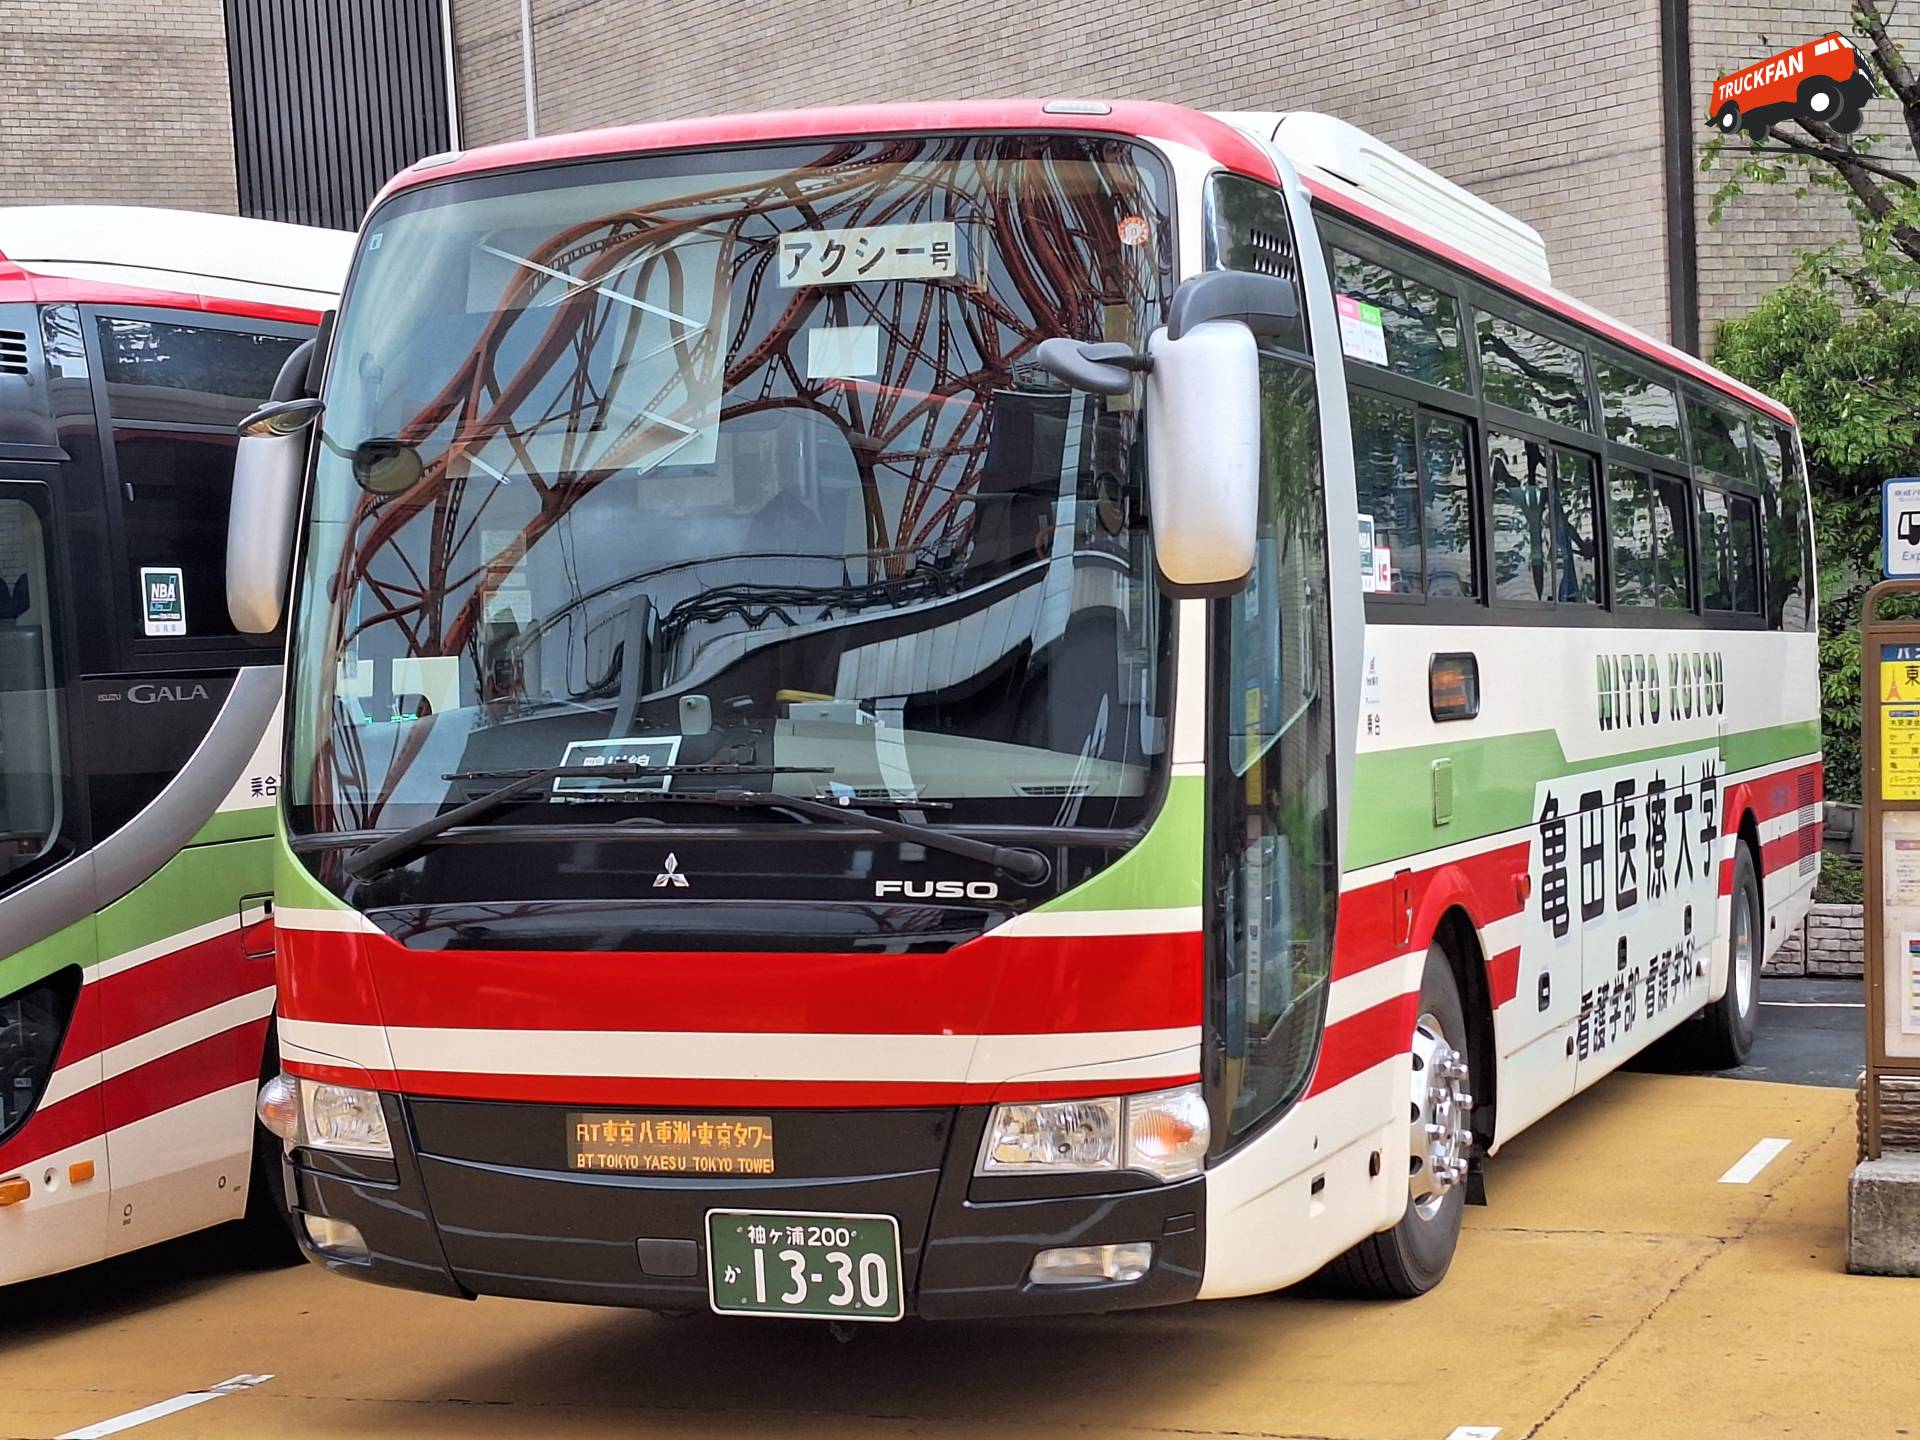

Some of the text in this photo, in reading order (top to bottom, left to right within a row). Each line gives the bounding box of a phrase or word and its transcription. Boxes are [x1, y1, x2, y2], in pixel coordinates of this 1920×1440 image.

[784, 237, 951, 280] アクシー号
[151, 583, 176, 599] NBA
[1596, 652, 1724, 731] NITTO KOTSU
[1904, 665, 1920, 686] 東
[127, 684, 209, 704] GALA
[1540, 759, 1717, 938] 亀田医療大学
[875, 880, 998, 899] FUSO
[1577, 966, 1639, 1061] 看護学部
[599, 1154, 638, 1168] TOKYO
[643, 1156, 686, 1170] YAESU
[693, 1157, 732, 1172] TOKYO
[724, 1248, 888, 1307] か 13-30
